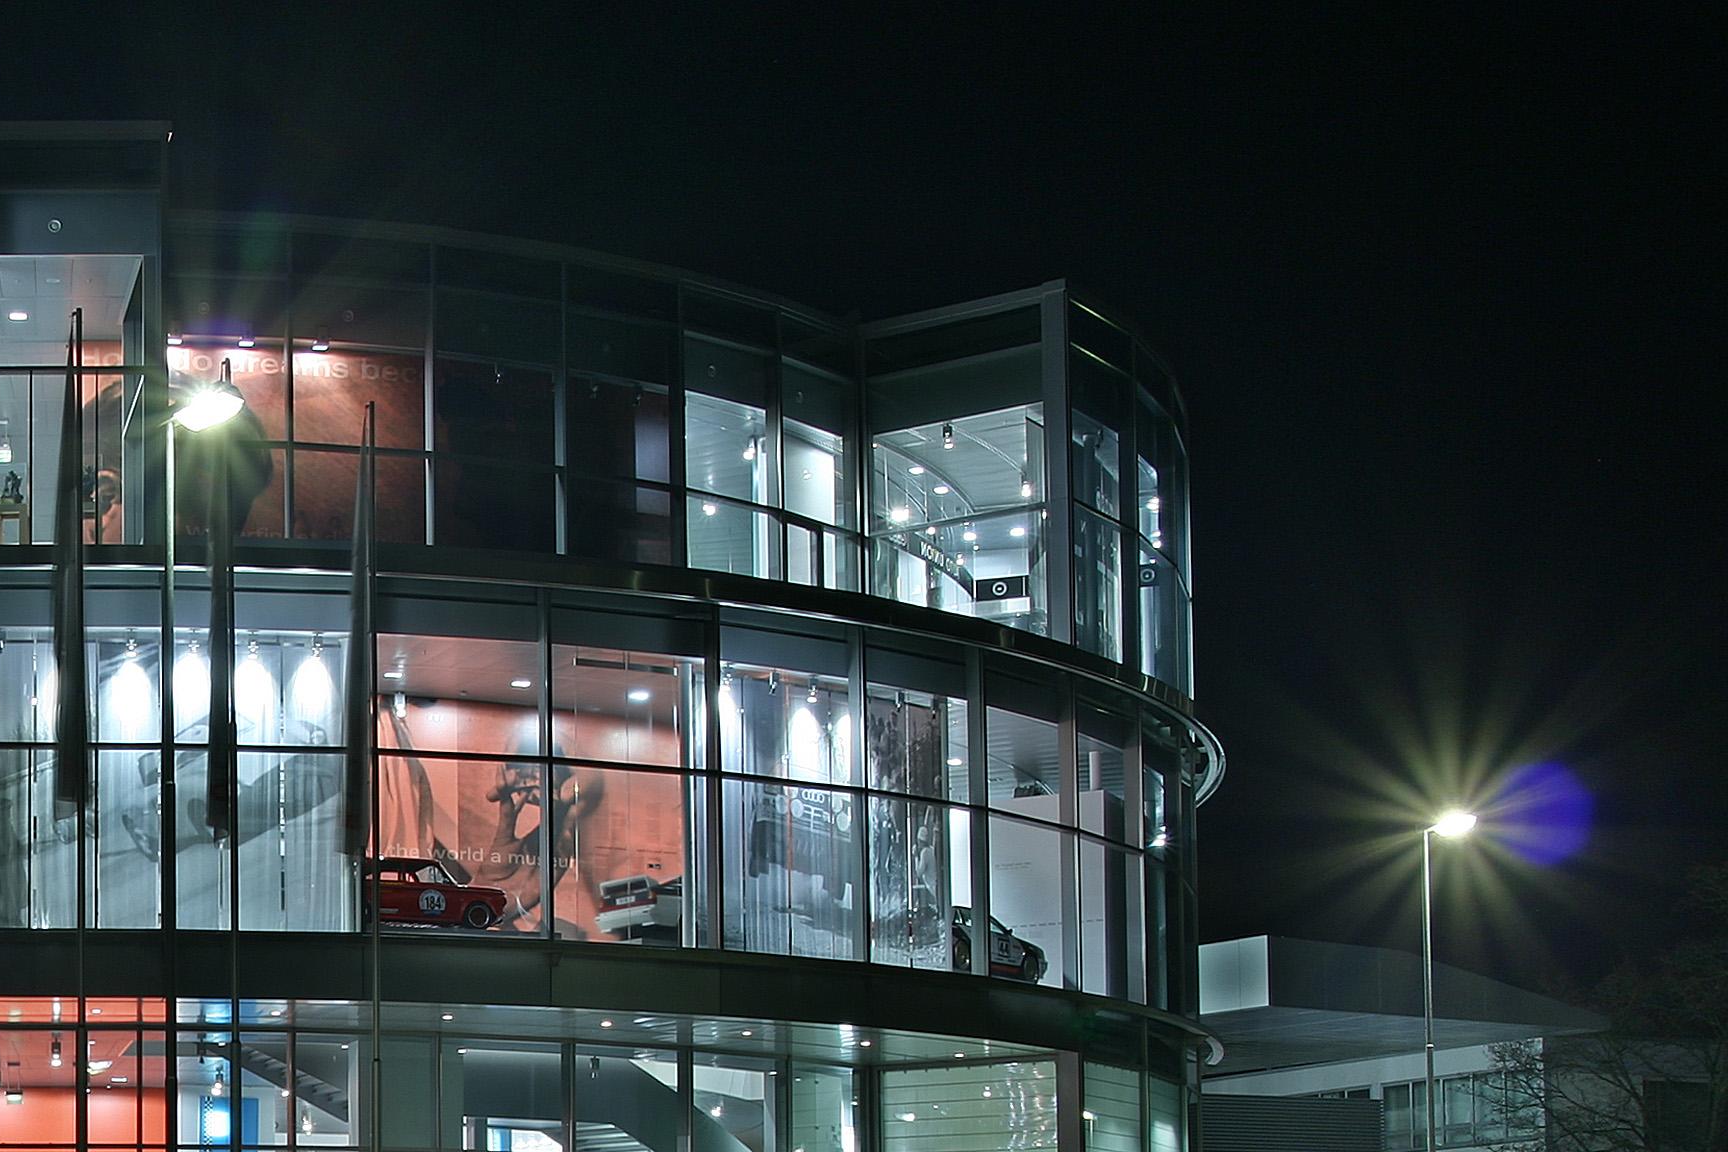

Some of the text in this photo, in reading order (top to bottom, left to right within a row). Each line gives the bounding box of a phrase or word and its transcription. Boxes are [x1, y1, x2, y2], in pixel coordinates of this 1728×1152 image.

[389, 843, 420, 857] the
[427, 846, 484, 861] world
[490, 851, 501, 863] a
[424, 895, 441, 910] 184
